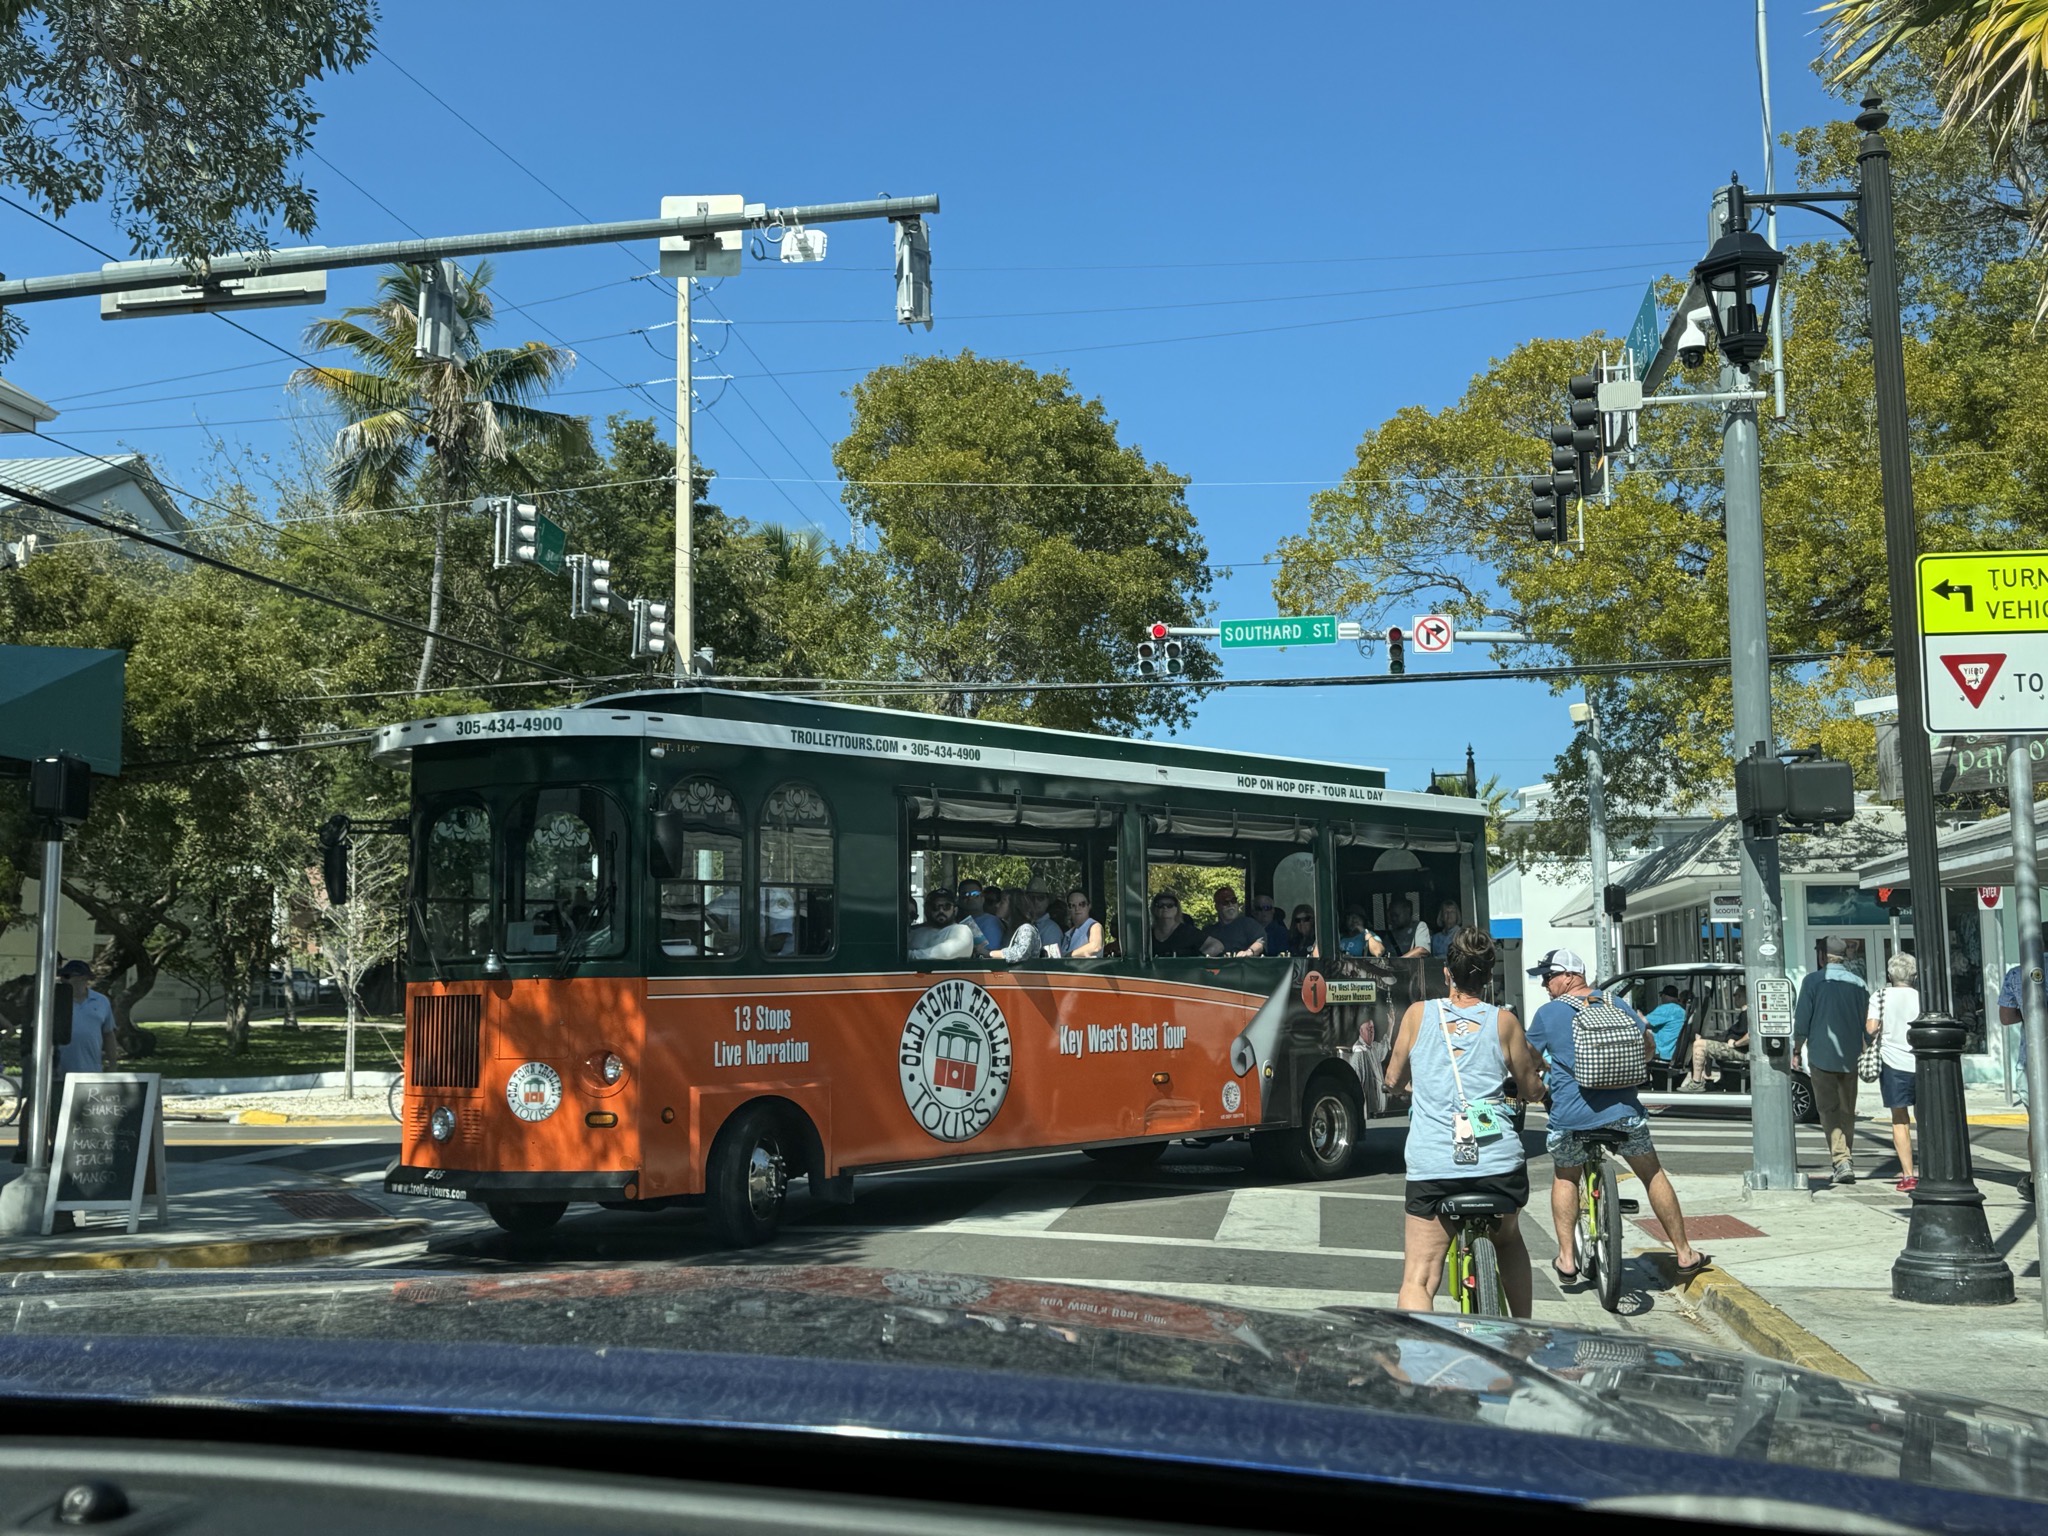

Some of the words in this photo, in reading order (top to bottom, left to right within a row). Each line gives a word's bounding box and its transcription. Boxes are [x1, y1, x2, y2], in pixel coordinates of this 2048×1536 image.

[1225, 624, 1301, 642] SOUTHARD
[1313, 623, 1332, 638] ST.
[1963, 667, 1984, 675] YIED
[2013, 673, 2044, 692] TO
[456, 716, 562, 735] 305-434-4900
[790, 729, 899, 753] TROLLEYTOURS.COM
[911, 743, 981, 761] 305-434-4900
[1237, 776, 1257, 788] HOP
[1260, 778, 1273, 790] ON
[1276, 780, 1295, 792] HOP
[1299, 783, 1315, 795] OFF
[1323, 786, 1347, 798] TOUR
[1349, 788, 1365, 800] ALL
[1367, 790, 1383, 801] DAY
[1311, 983, 1317, 1007] 1
[734, 1005, 751, 1032] 13
[756, 1005, 791, 1034] Stops
[901, 1021, 925, 1067] OLD
[916, 982, 964, 1025] TOWN
[968, 986, 1010, 1085] TROLLEY
[1060, 1025, 1083, 1058] Key
[1087, 1023, 1127, 1053] West's
[1131, 1022, 1158, 1051] Best
[1162, 1021, 1186, 1049] Tour
[714, 1040, 742, 1067] Live
[746, 1038, 809, 1065] Narration
[507, 1081, 518, 1098] OLD
[514, 1063, 535, 1081] TOWN
[538, 1063, 562, 1098] TROLLEY
[87, 1087, 120, 1102] Rum
[82, 1104, 127, 1117] SHAKES
[514, 1102, 554, 1121] TOURS
[911, 1082, 992, 1140] TOURS
[76, 1152, 113, 1166] PEACH
[71, 1170, 116, 1184] MANGO
[391, 1183, 467, 1200] www.trolleytours.com
